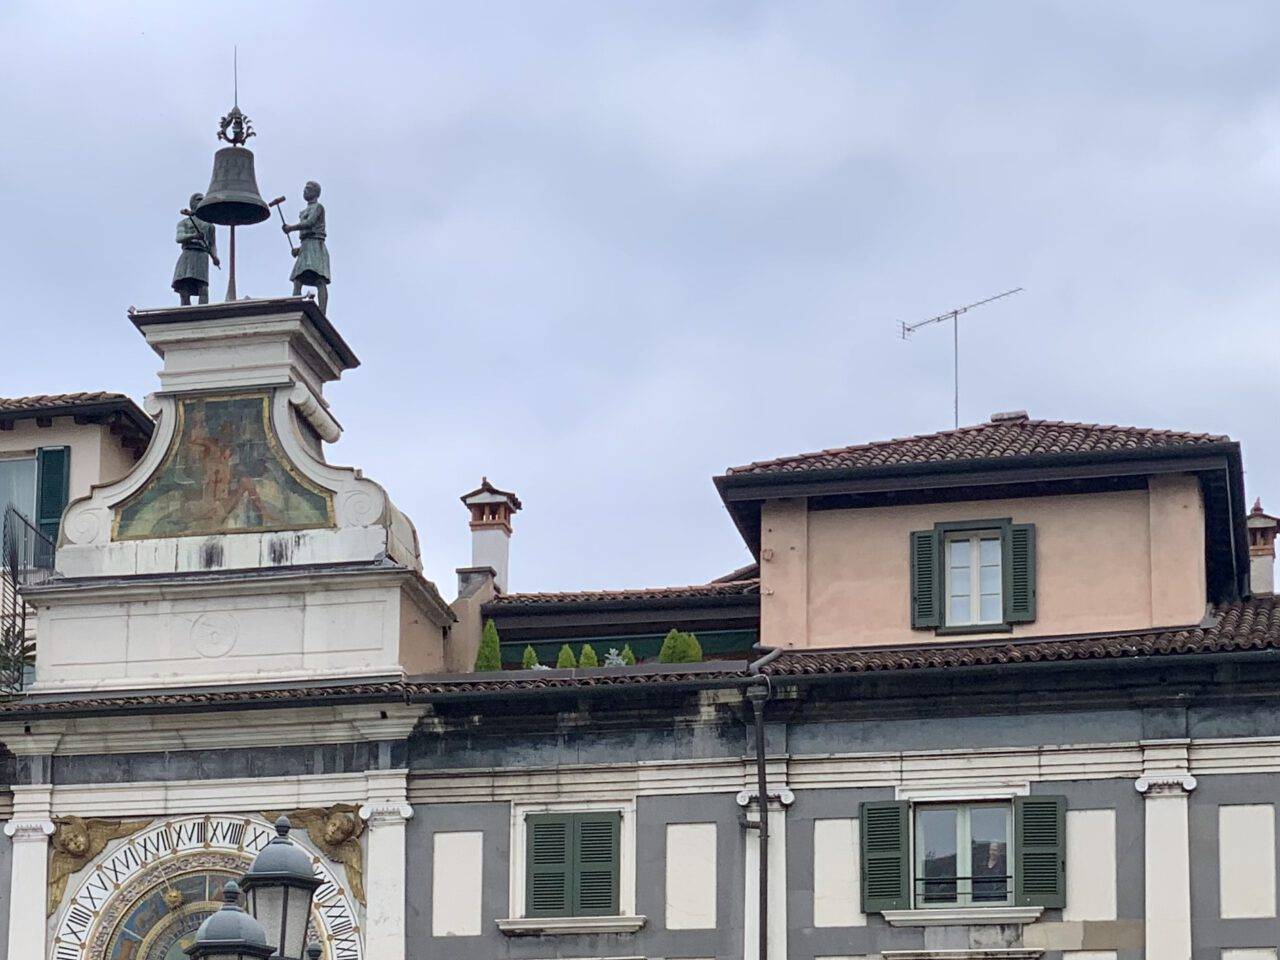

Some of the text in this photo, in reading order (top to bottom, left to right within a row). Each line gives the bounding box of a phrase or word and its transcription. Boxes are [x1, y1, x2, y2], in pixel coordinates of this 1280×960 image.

[137, 829, 172, 861] XVII
[173, 822, 206, 847] XVIII
[104, 847, 139, 881] XVI
[80, 874, 109, 909] XV
[62, 907, 92, 945] XIIII
